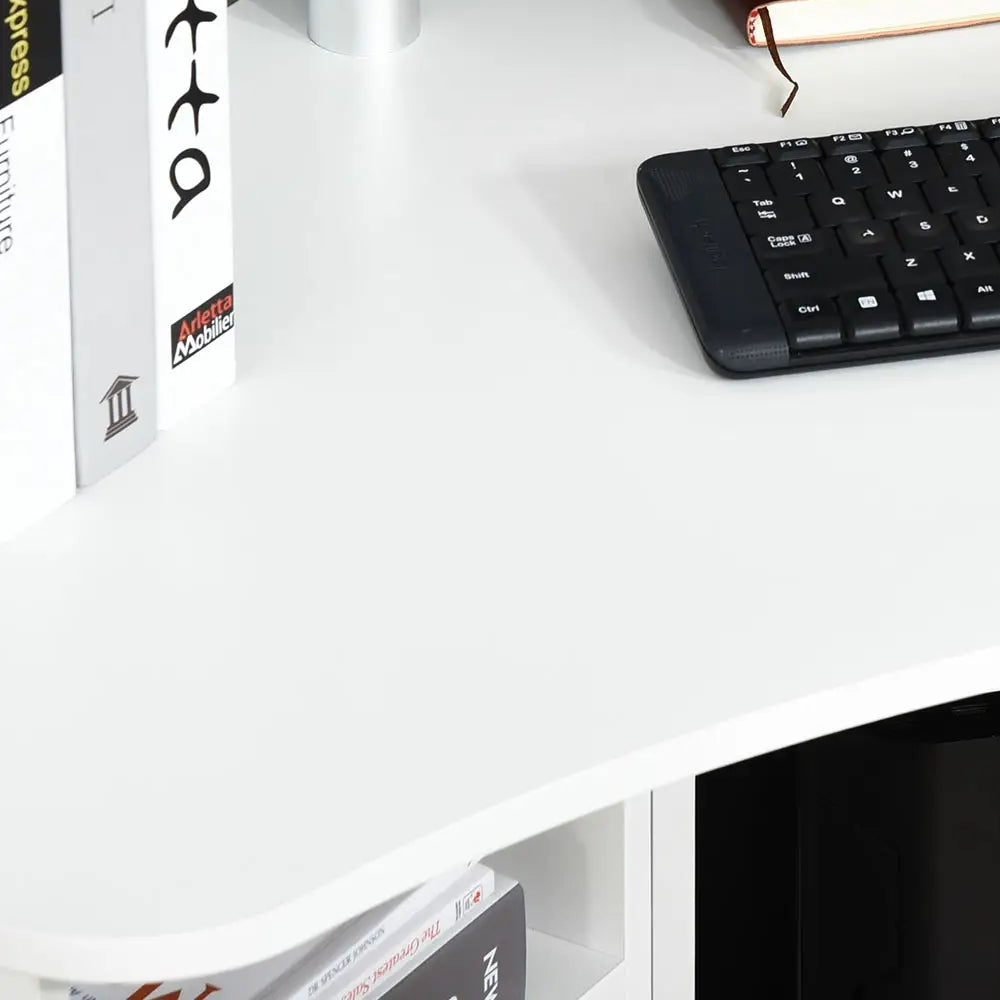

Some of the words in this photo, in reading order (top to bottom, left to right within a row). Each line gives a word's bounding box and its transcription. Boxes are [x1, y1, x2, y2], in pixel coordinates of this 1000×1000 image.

[731, 145, 751, 153] Esc
[887, 190, 902, 198] W
[832, 197, 845, 205] Q
[767, 235, 795, 243] Caps
[770, 240, 797, 248] Lock
[964, 252, 975, 260] X
[799, 305, 819, 313] Ctrl
[179, 294, 233, 341] Arletta
[173, 311, 235, 366] Mobilier
[421, 919, 441, 941] The
[373, 937, 420, 982] Greatest
